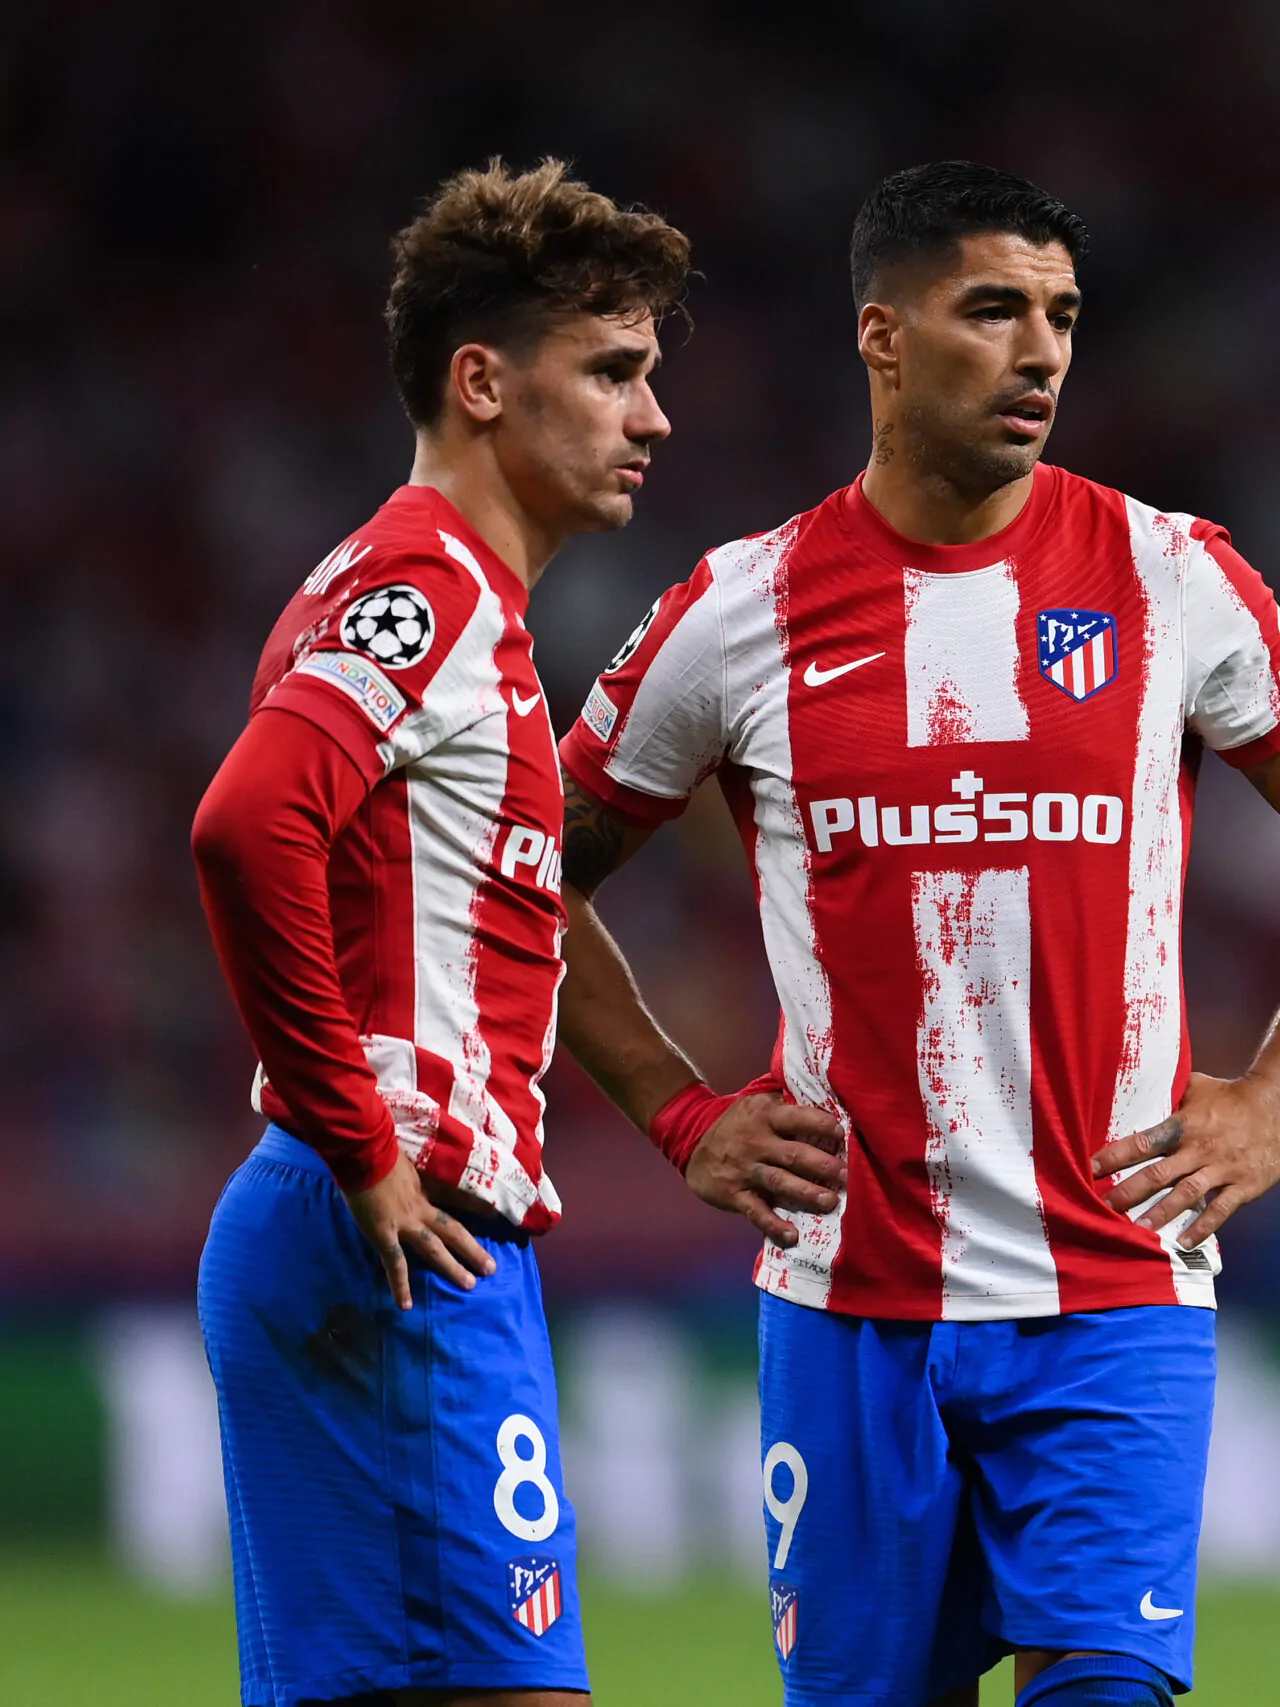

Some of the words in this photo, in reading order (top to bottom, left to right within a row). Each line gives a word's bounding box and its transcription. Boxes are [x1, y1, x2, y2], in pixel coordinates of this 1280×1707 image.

[809, 792, 1123, 852] Plus500
[493, 1413, 559, 1542] 8
[763, 1441, 808, 1569] 9
